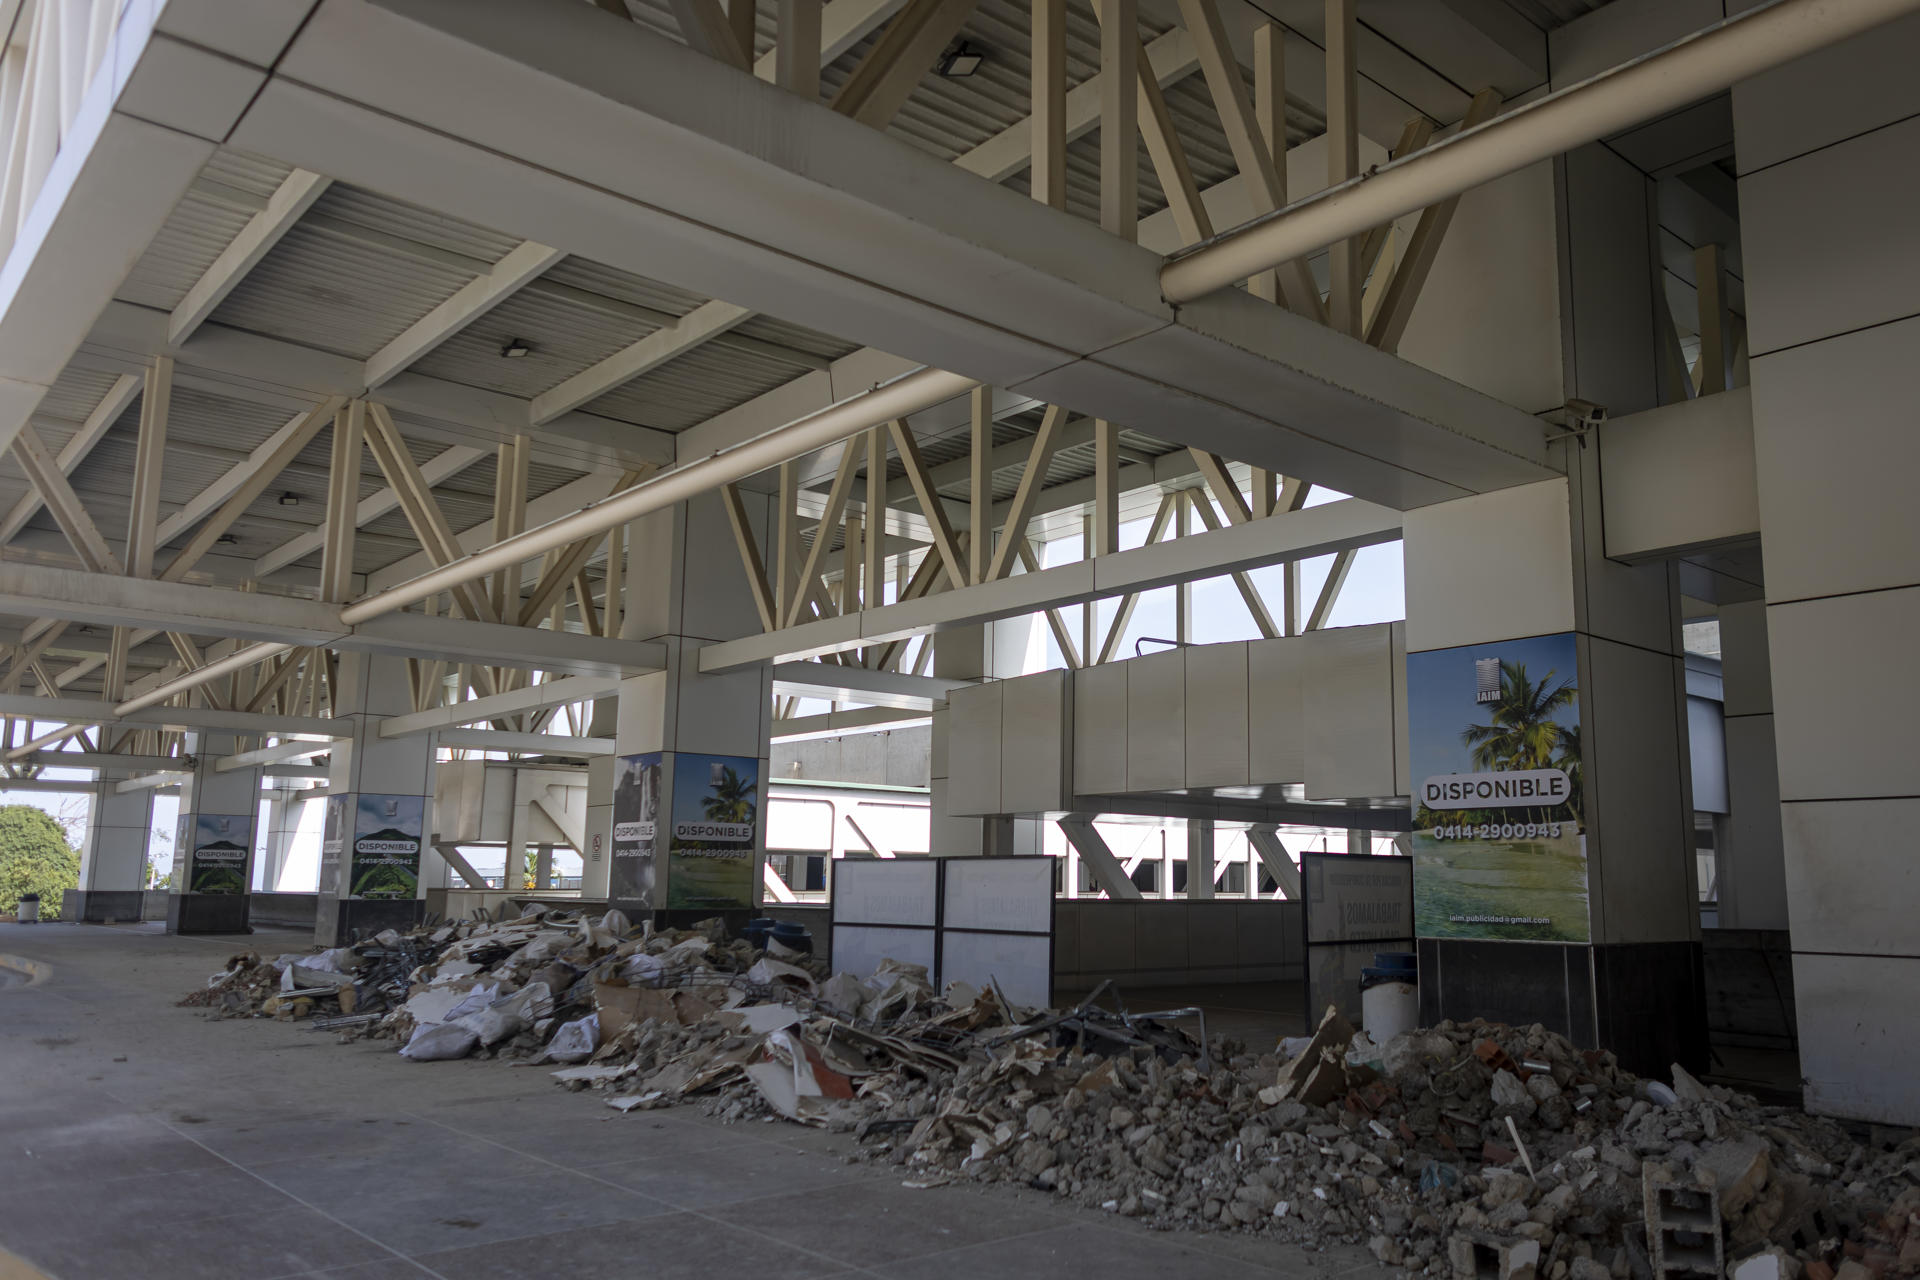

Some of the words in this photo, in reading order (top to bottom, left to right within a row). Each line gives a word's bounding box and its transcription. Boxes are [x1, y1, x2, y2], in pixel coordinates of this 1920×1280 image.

[1477, 691, 1500, 702] IAIM
[1426, 777, 1564, 801] DISPONIBLE
[616, 825, 654, 837] DISPONIBLE
[677, 825, 749, 837] DISPONIBLE
[1433, 823, 1561, 840] 0414-2900943
[358, 842, 416, 851] DISPONIBLE
